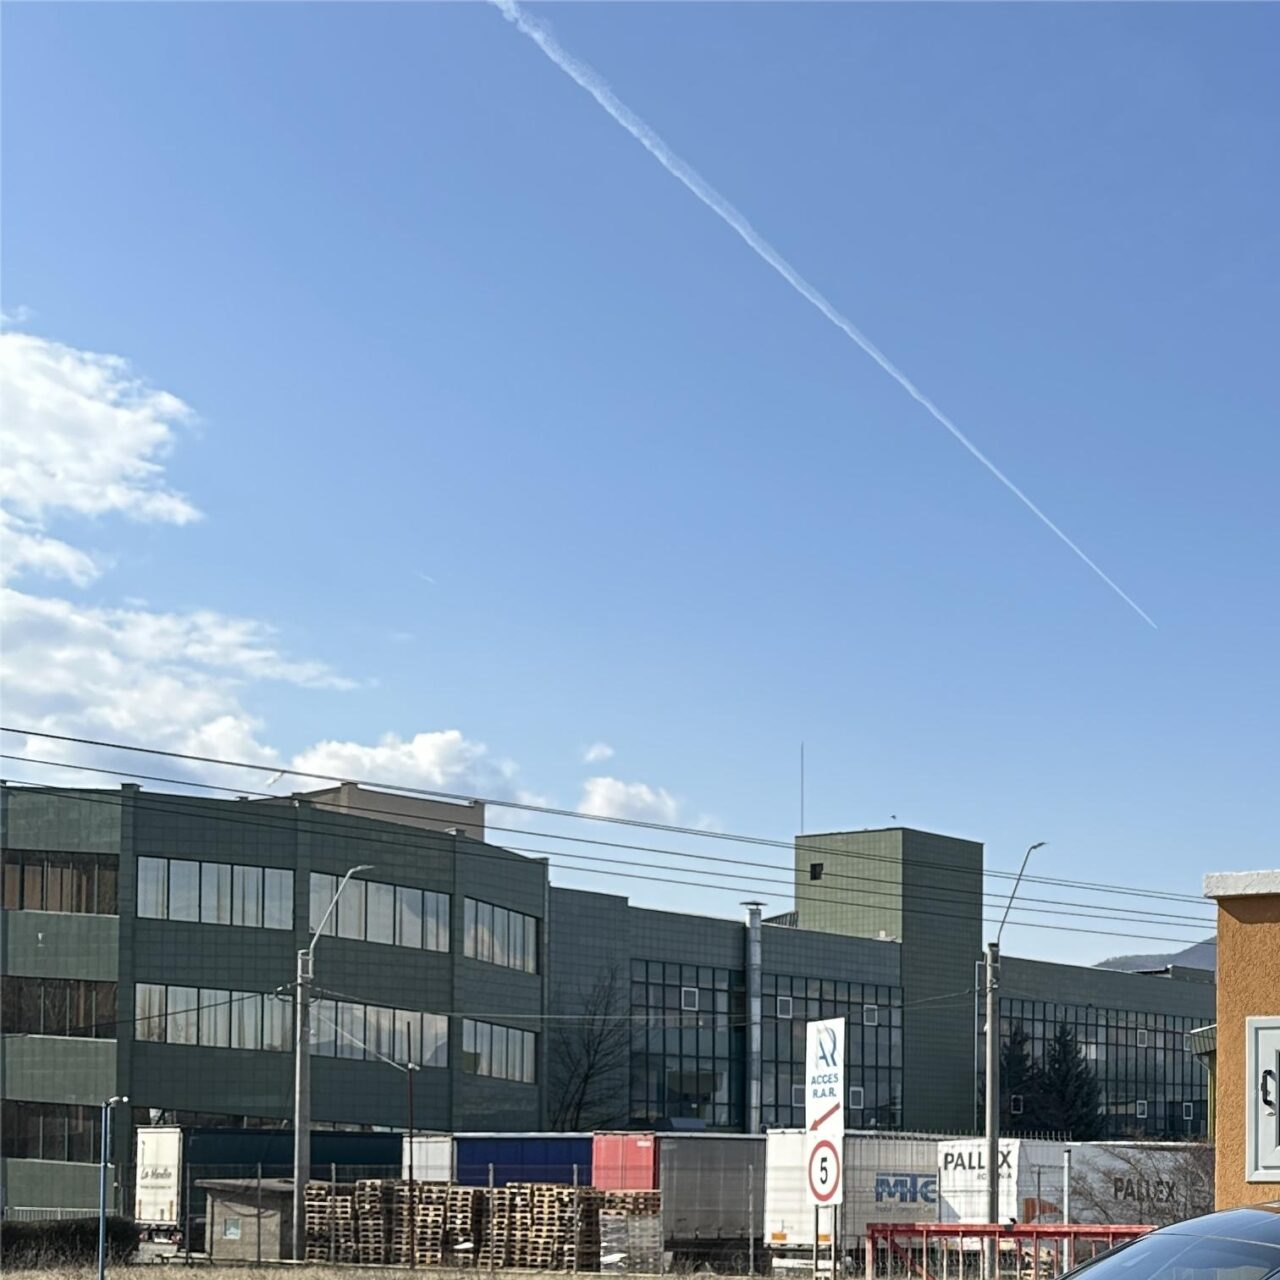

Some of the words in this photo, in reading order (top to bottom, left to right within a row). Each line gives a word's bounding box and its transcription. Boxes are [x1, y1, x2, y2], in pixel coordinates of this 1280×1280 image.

[811, 1073, 839, 1085] ACCES
[812, 1087, 837, 1098] R.A.R.
[944, 1151, 1012, 1171] PALLX
[820, 1157, 828, 1185] 5
